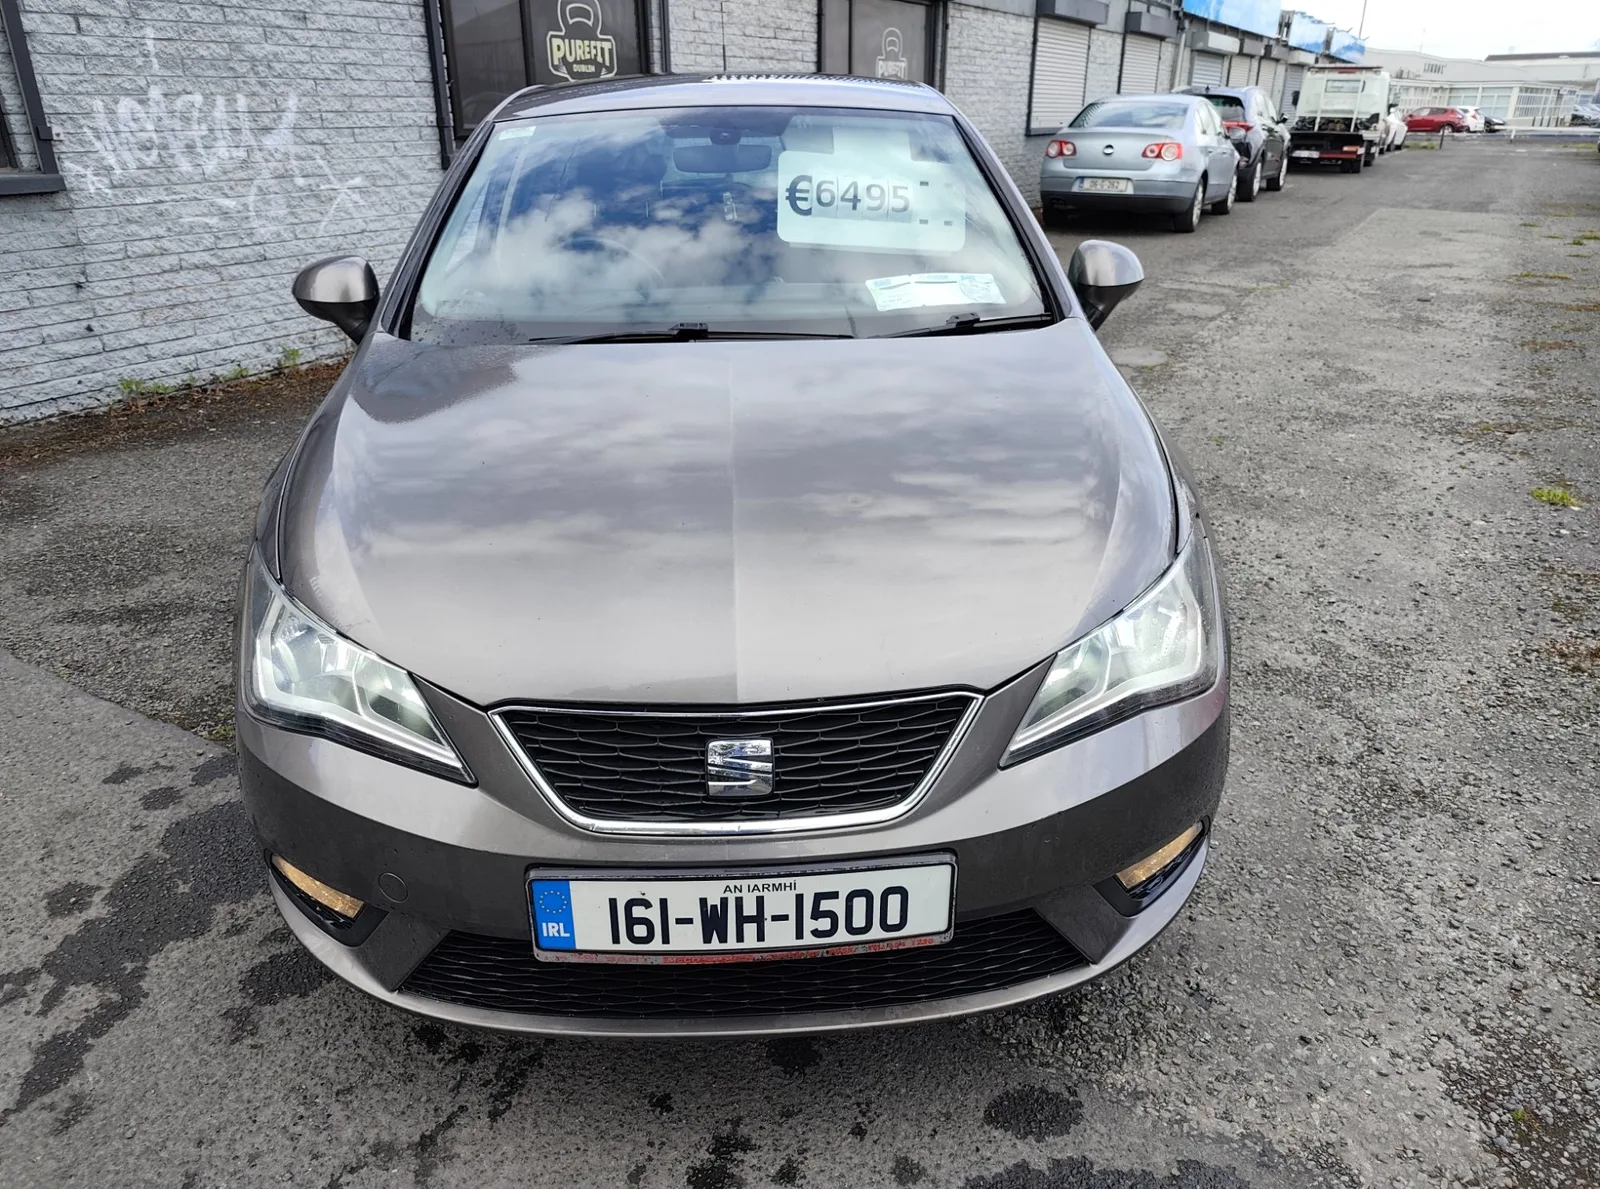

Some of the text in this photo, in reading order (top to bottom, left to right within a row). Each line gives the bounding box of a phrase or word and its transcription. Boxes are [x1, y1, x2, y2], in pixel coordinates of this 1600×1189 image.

[551, 37, 612, 67] PUREFIT
[573, 64, 596, 73] DUBLIN
[785, 174, 910, 216] €6495
[723, 884, 742, 894] AN
[608, 885, 909, 945] 161-WH-1500
[542, 922, 570, 937] IRL
